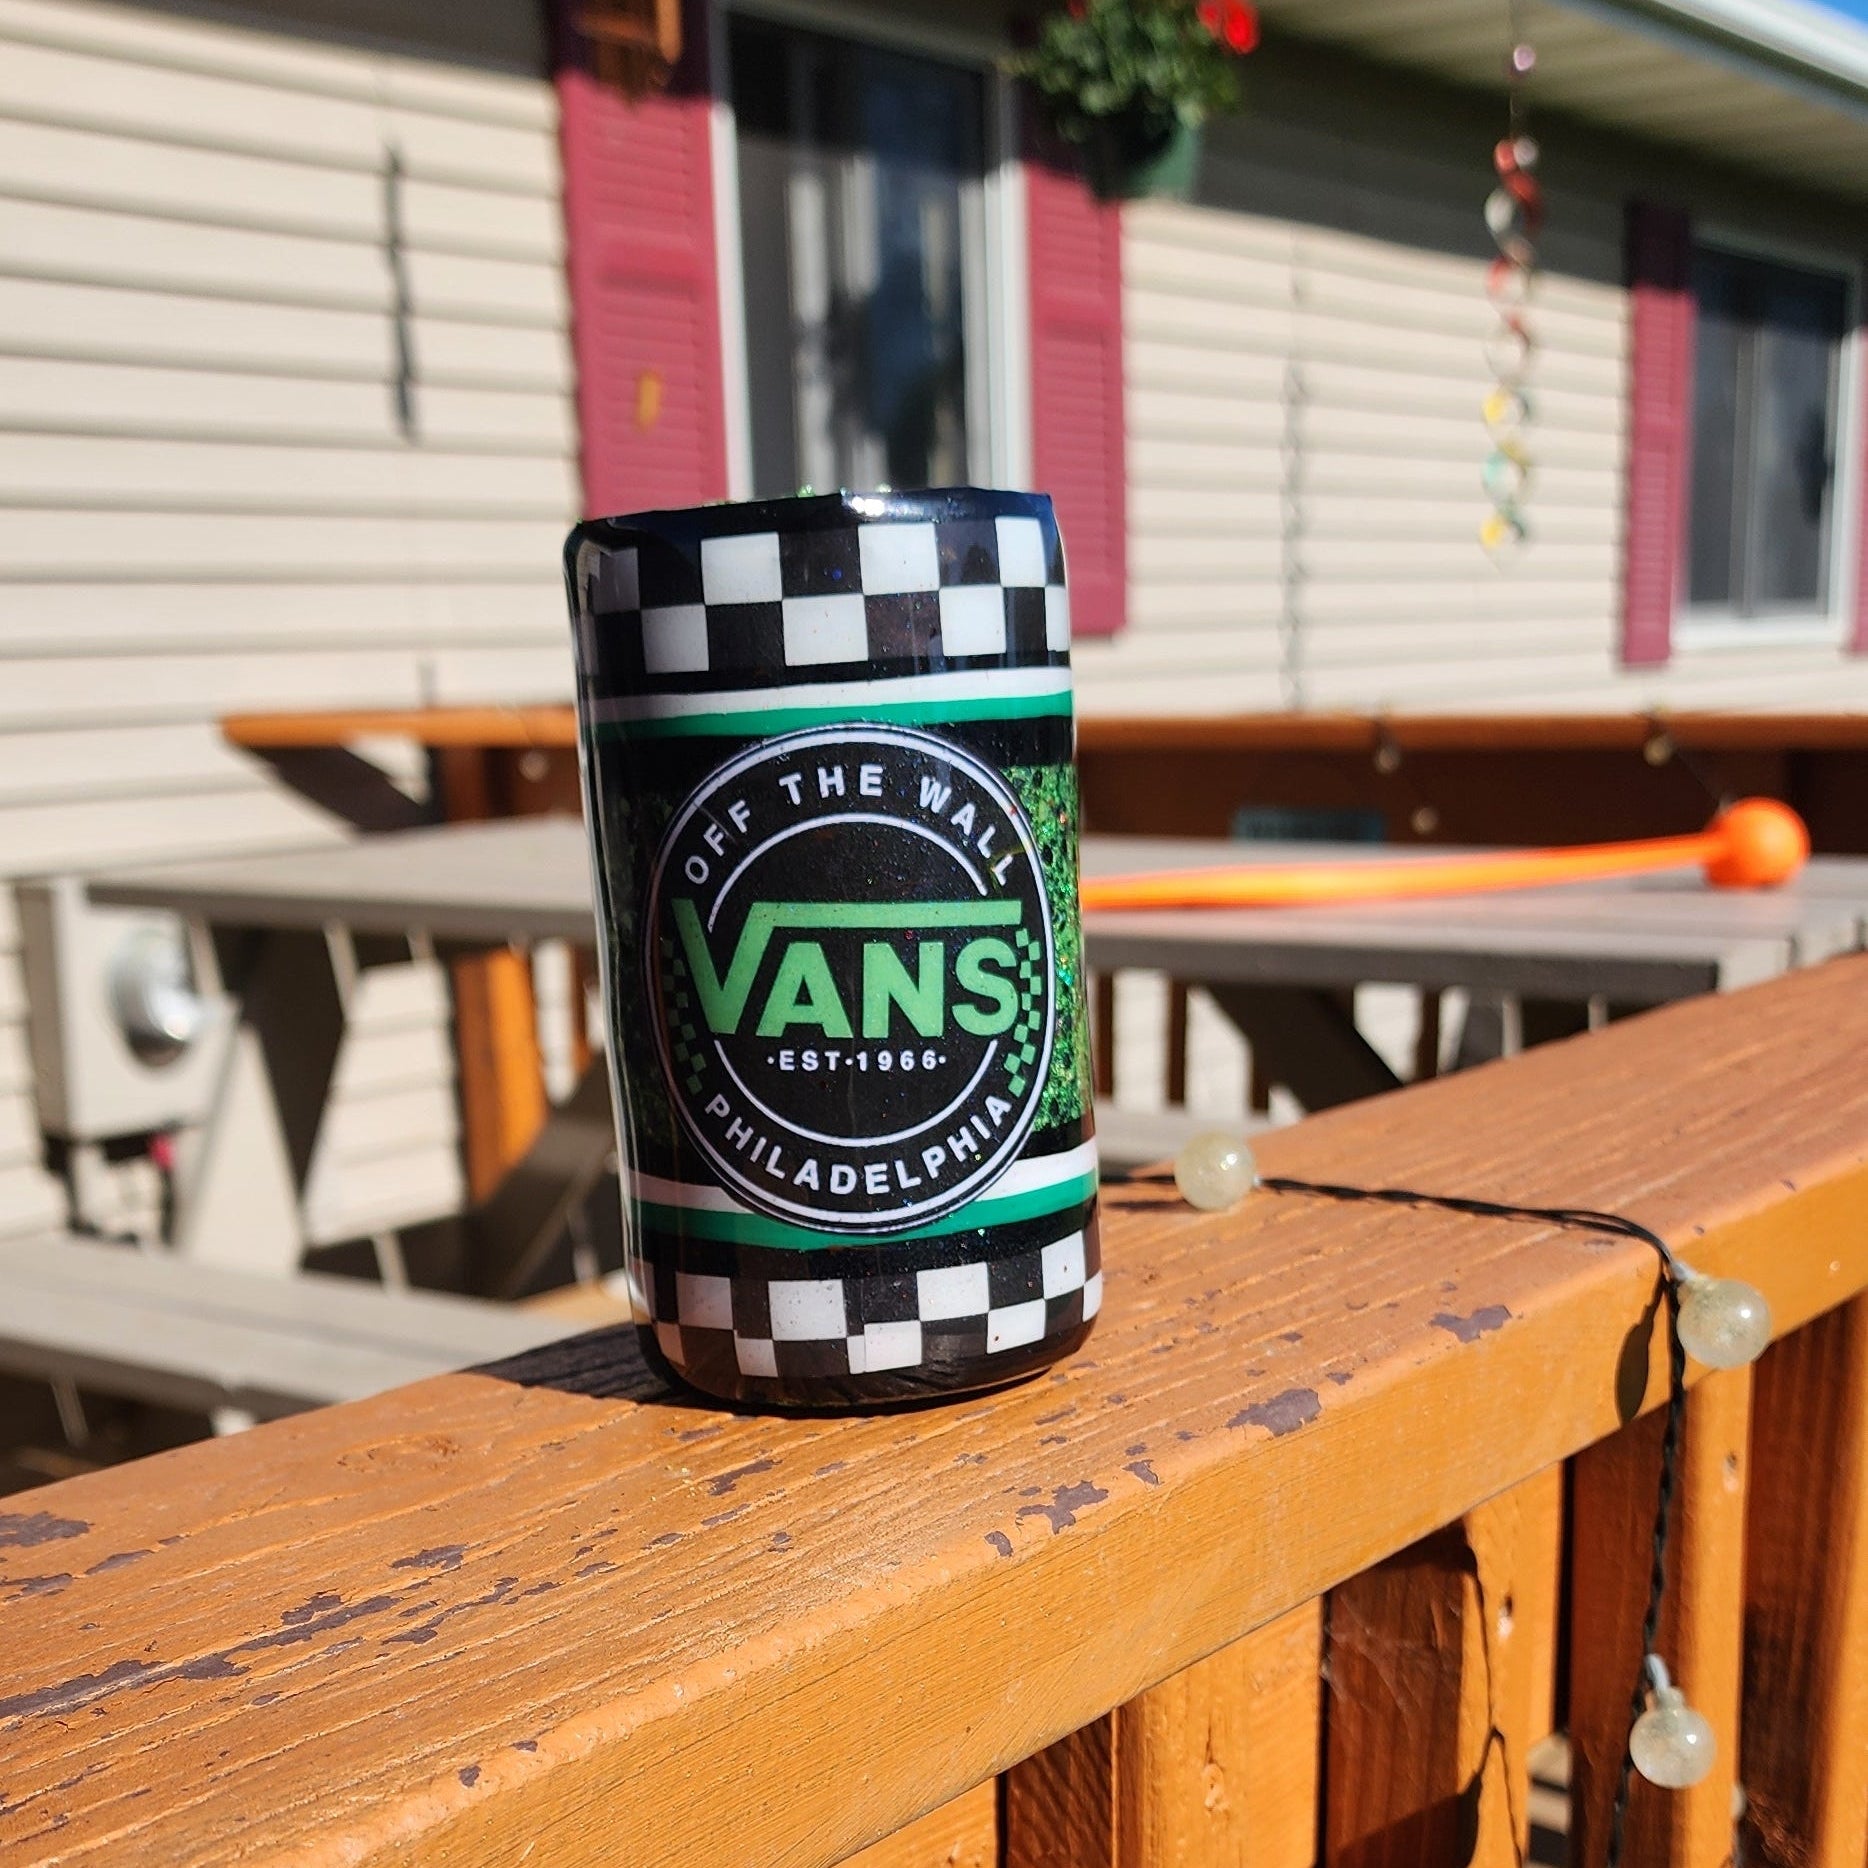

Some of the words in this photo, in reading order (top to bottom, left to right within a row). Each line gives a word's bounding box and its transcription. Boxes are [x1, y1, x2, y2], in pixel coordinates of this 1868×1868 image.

[684, 799, 754, 885] OFF
[778, 763, 884, 806] THE
[918, 775, 1015, 887] WALL
[671, 899, 1022, 1039] VANS
[704, 1093, 1012, 1196] PHILADELPHIA
